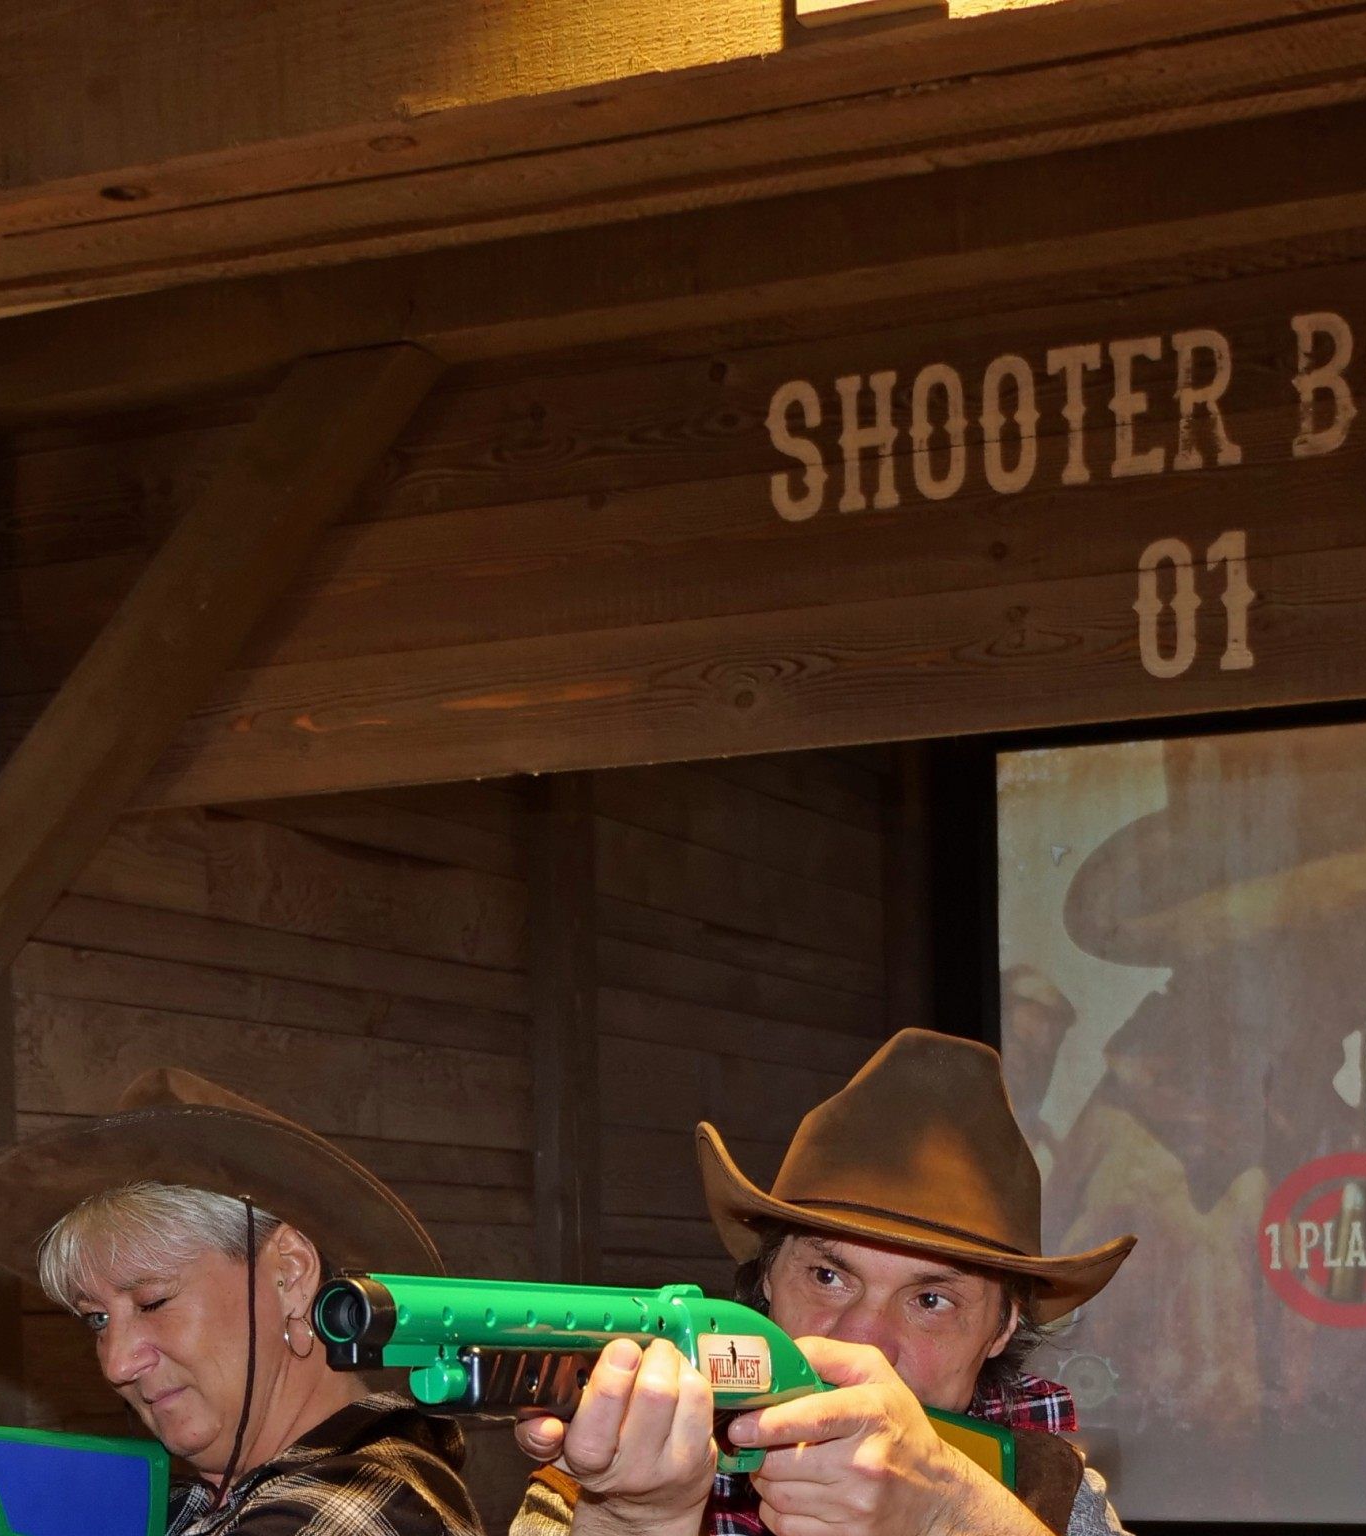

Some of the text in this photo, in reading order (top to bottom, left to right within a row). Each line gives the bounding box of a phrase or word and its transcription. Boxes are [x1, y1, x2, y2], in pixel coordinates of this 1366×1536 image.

[764, 328, 1243, 522] SHOOTER
[1132, 530, 1257, 679] 01
[1264, 1222, 1283, 1270] 1
[709, 1357, 761, 1385] WILD WEST
